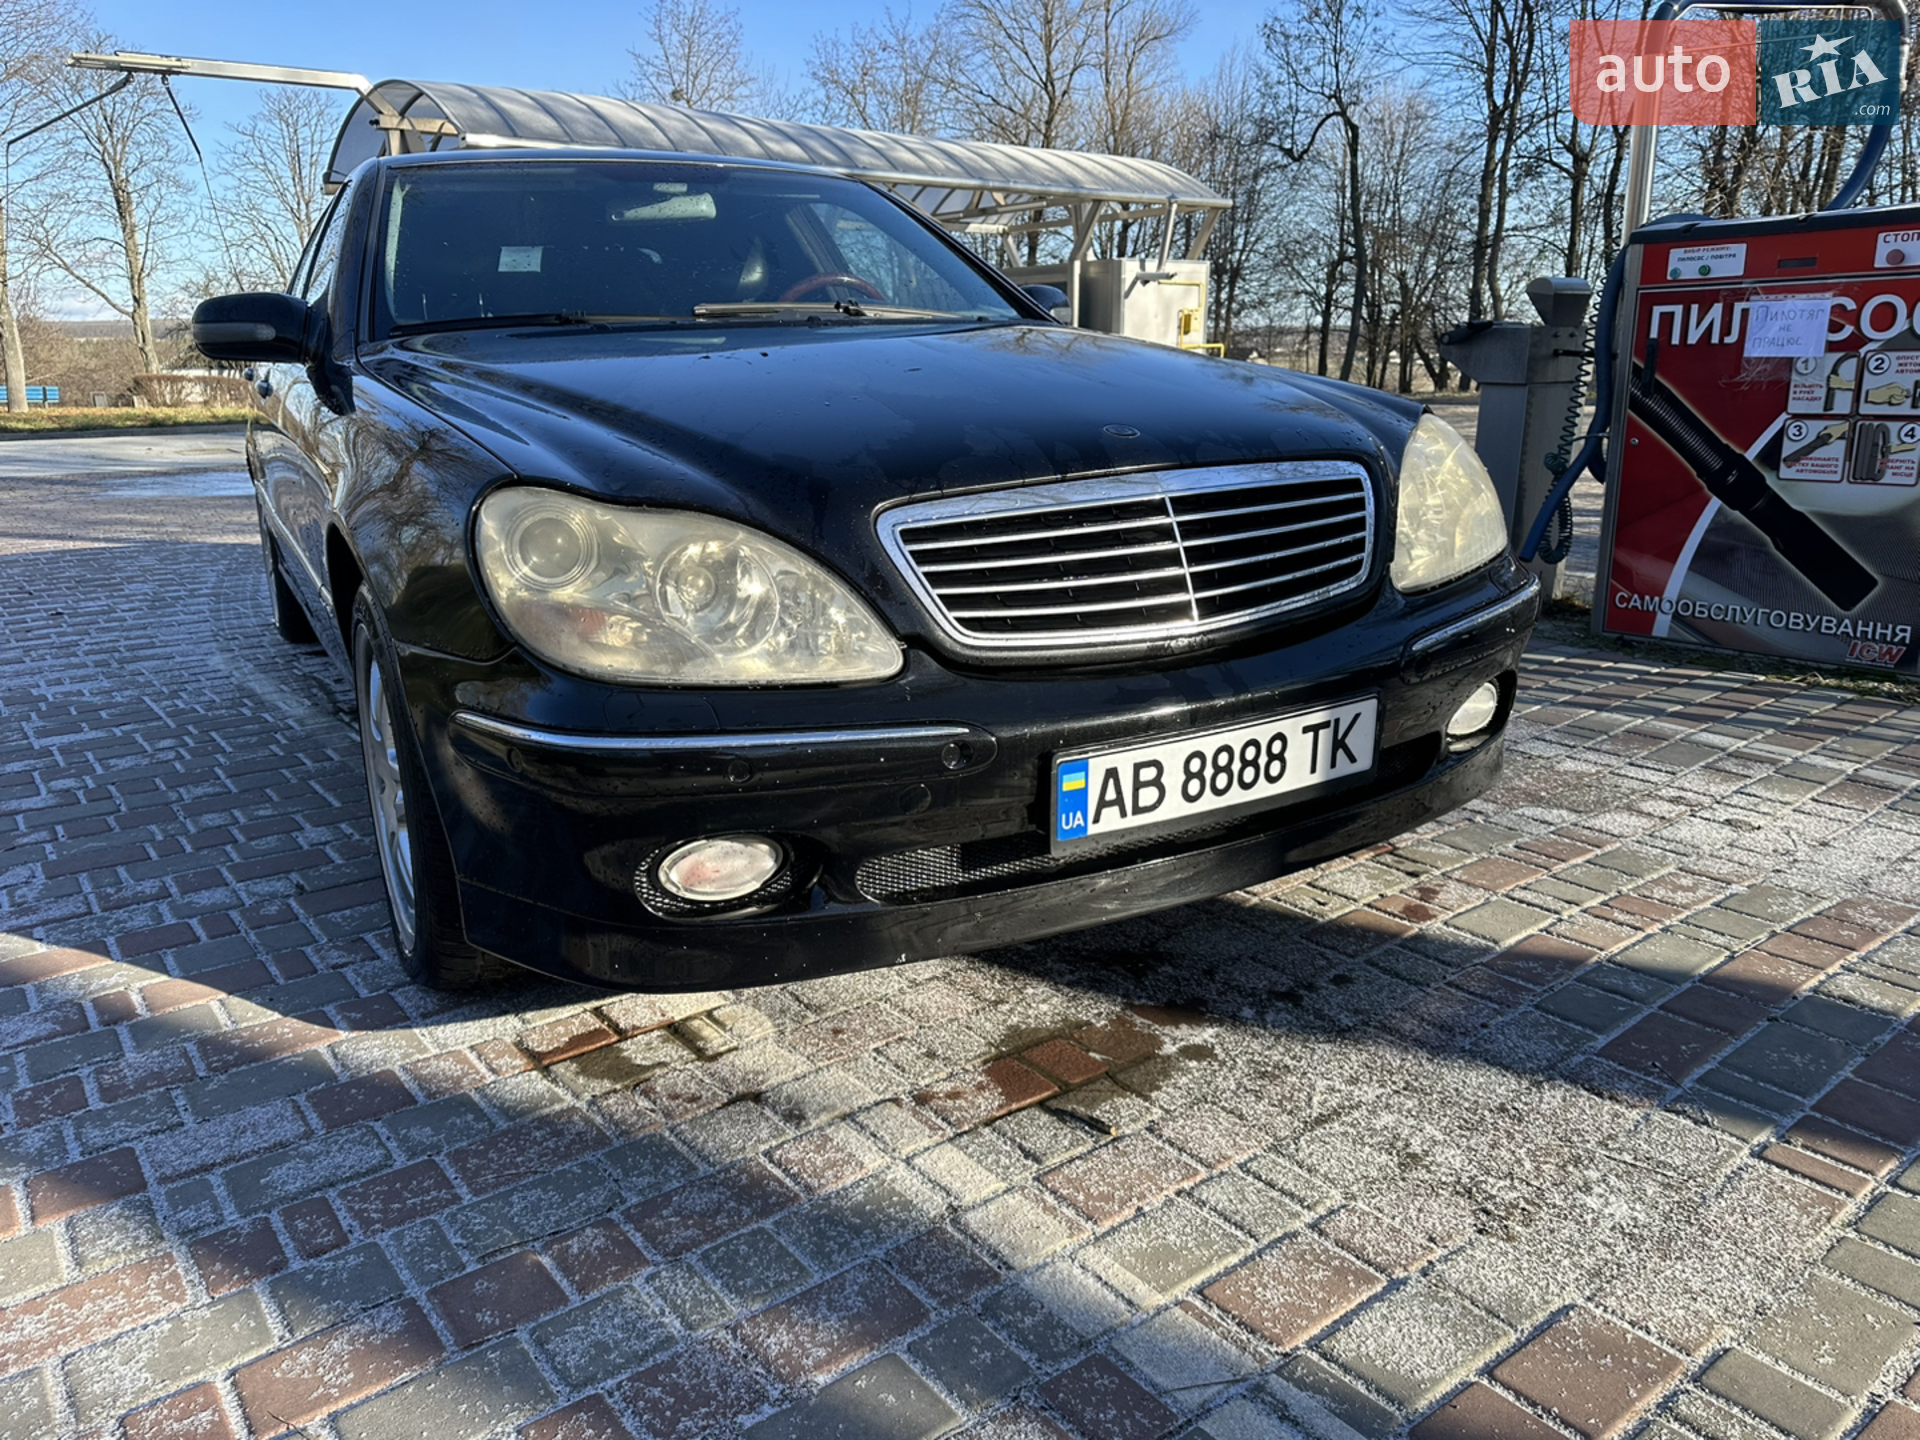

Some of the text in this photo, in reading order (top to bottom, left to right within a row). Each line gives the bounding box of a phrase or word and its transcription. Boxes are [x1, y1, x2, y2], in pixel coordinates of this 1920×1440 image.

[1883, 232, 1920, 243] СТОП
[1801, 357, 1809, 371] 1
[1873, 357, 1885, 371] 2
[1792, 424, 1803, 437] 3
[1904, 426, 1916, 440] 4
[1614, 591, 1912, 644] САМООБСЛУГОВУВАННЯ
[1846, 640, 1907, 664] ICW
[1092, 712, 1362, 824] AB 8888 TK
[1061, 810, 1085, 830] UA
